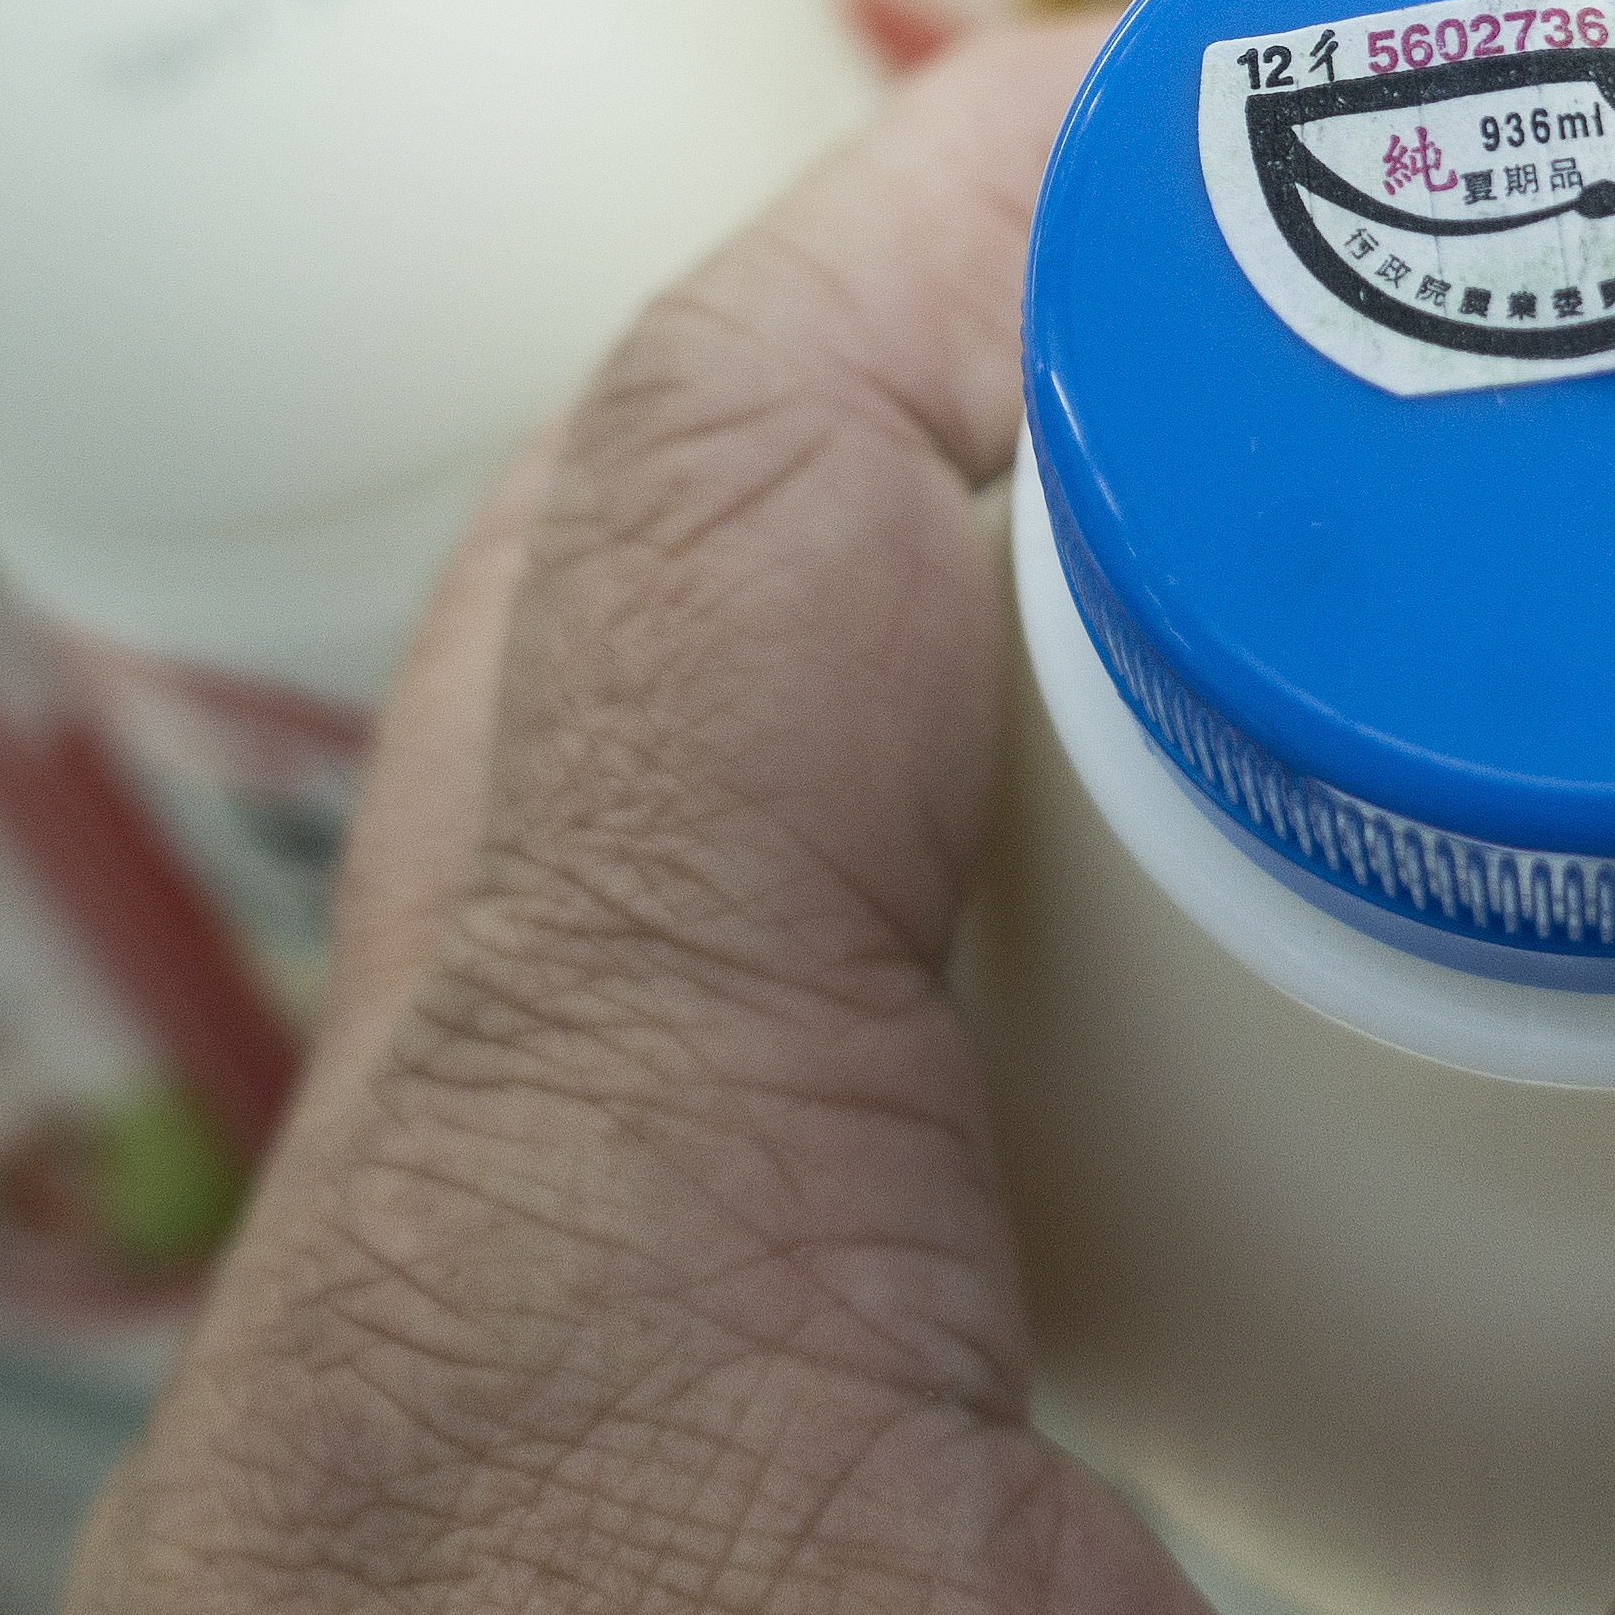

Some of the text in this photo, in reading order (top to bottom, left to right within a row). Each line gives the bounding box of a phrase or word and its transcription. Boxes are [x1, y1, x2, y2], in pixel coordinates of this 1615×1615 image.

[1237, 45, 1294, 90] 12
[1367, 6, 1610, 74] 5602736
[1479, 101, 1605, 152] 936ml
[1382, 125, 1459, 196] 純
[1460, 156, 1583, 205] 夏期品
